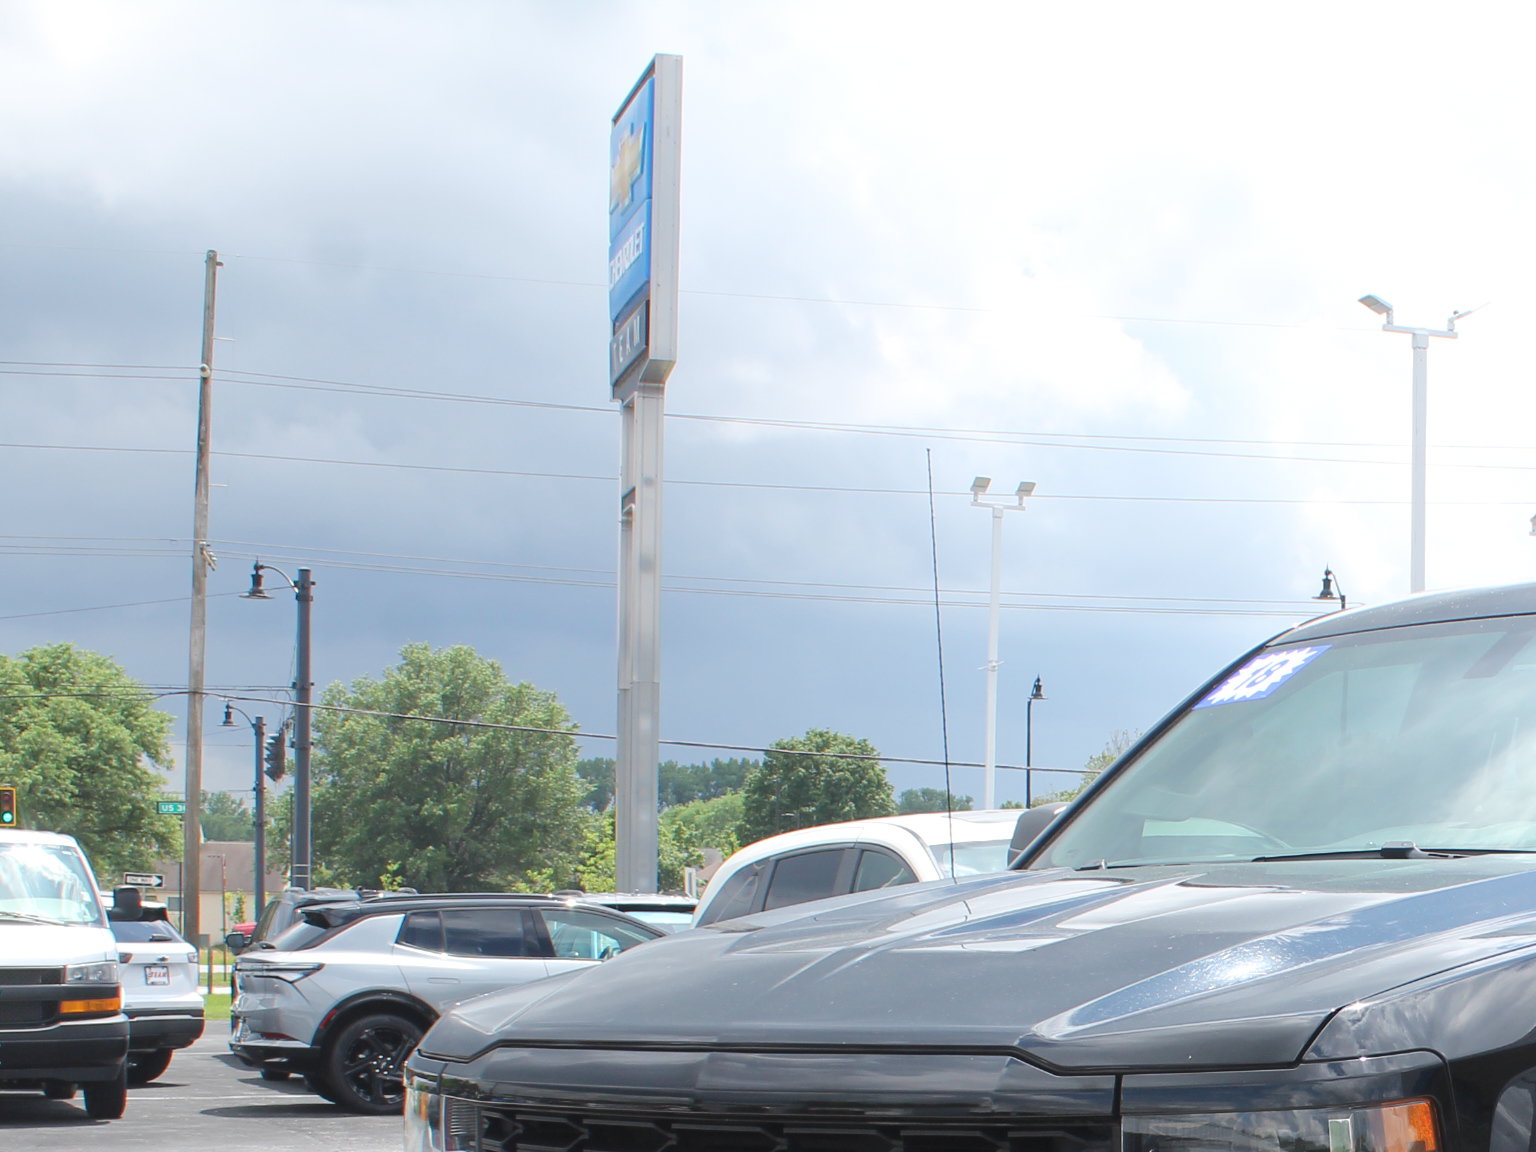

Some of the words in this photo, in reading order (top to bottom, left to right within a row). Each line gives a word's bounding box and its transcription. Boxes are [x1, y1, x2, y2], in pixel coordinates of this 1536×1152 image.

[613, 315, 641, 374] TEAM
[1234, 659, 1290, 690] 18
[161, 804, 174, 812] US
